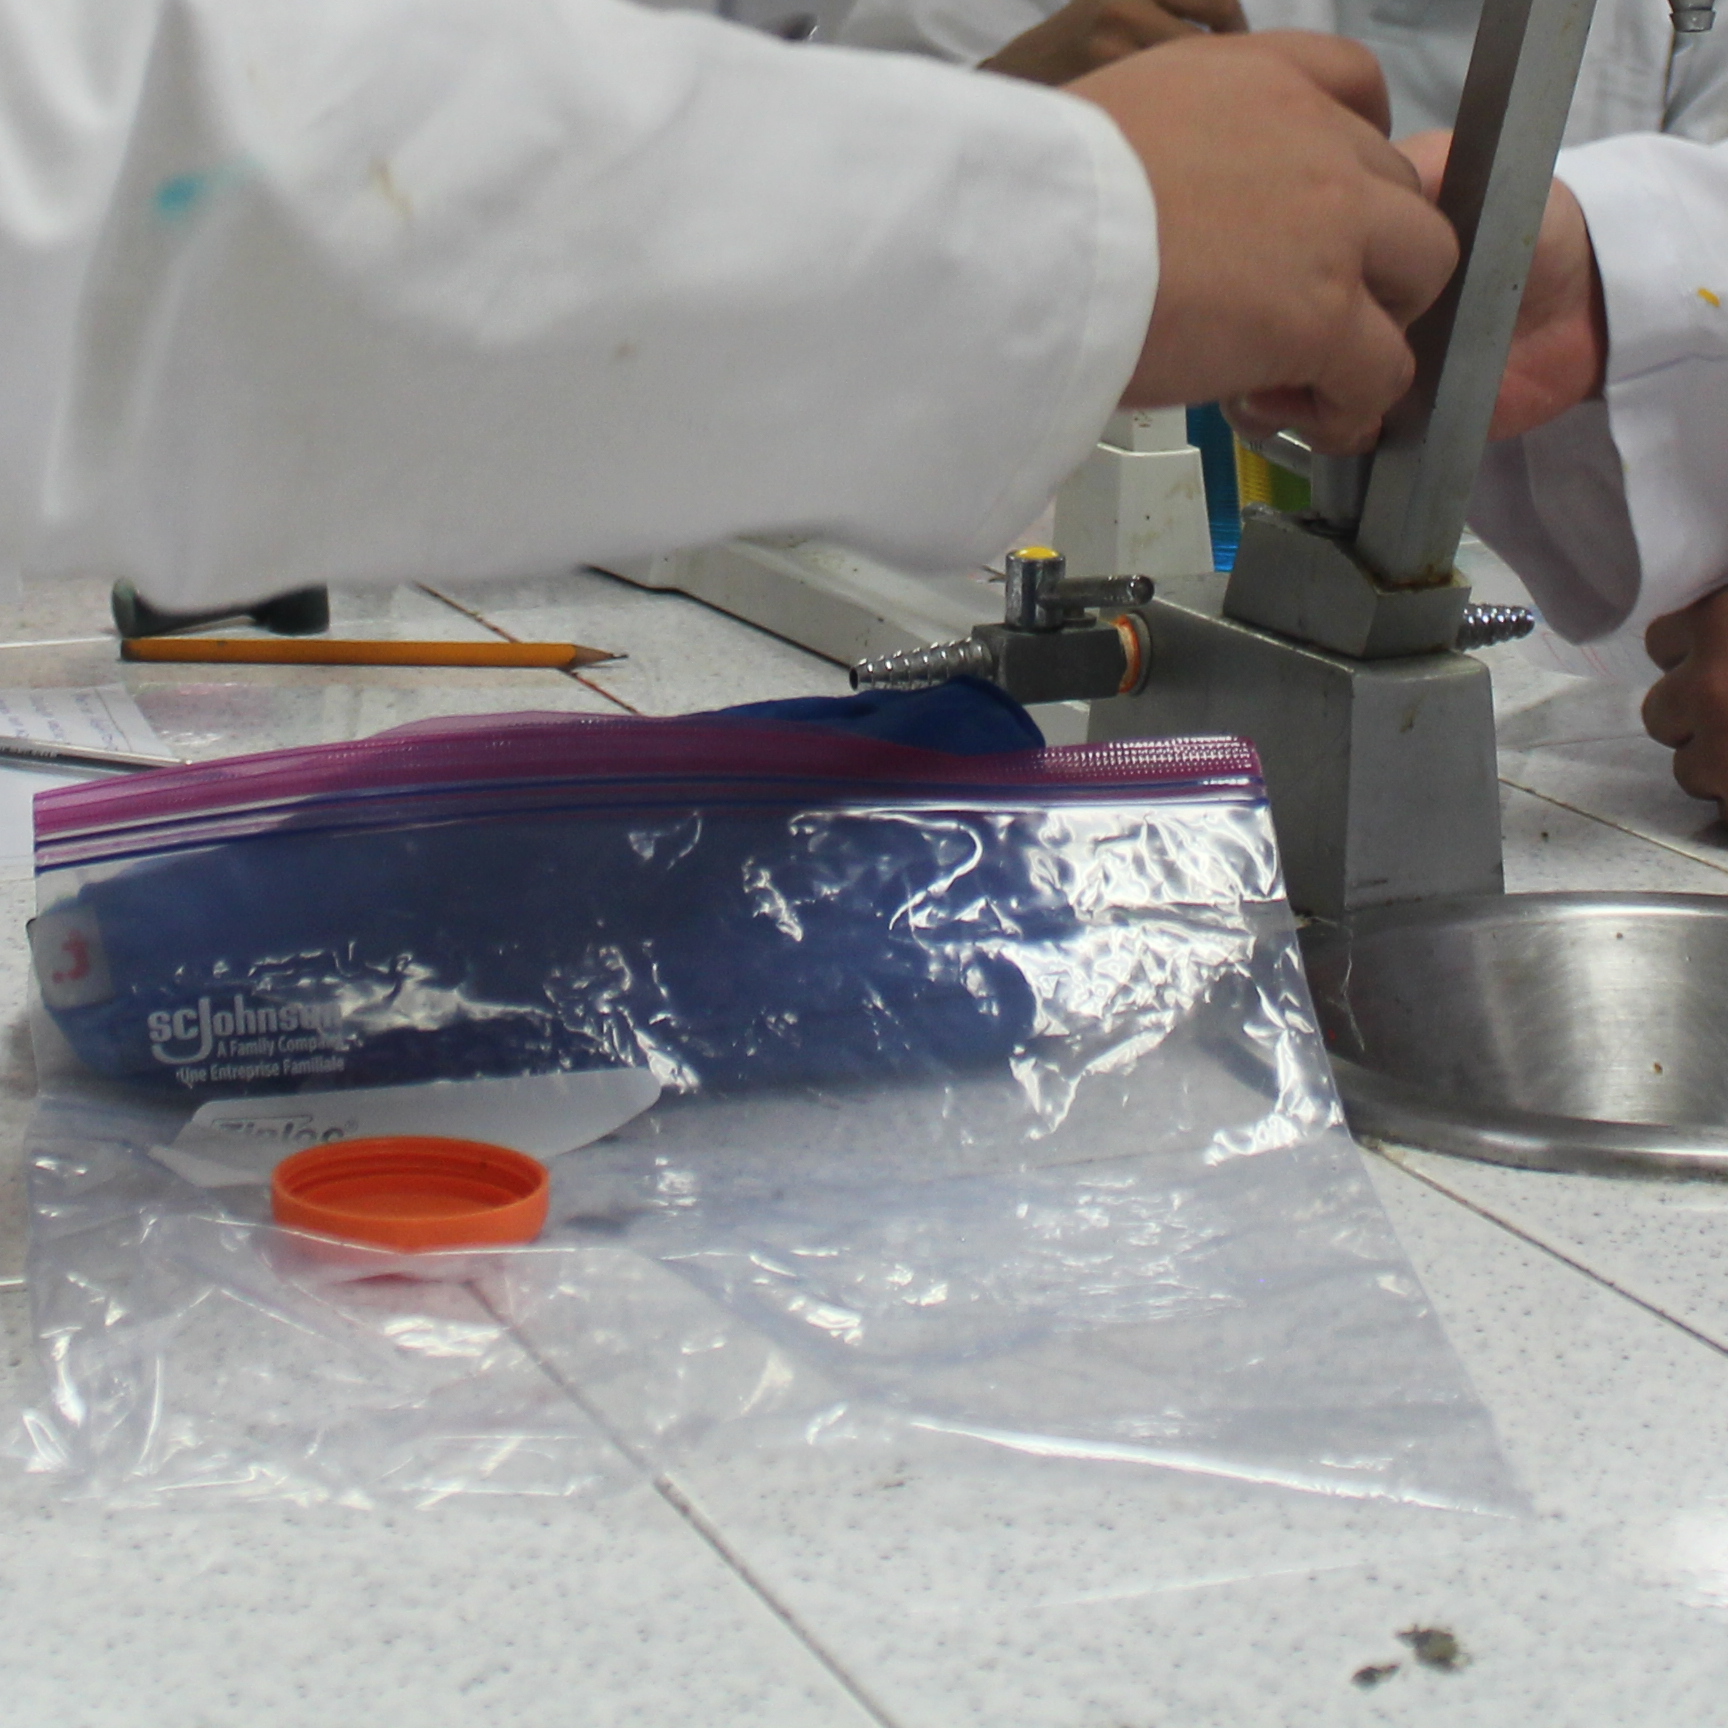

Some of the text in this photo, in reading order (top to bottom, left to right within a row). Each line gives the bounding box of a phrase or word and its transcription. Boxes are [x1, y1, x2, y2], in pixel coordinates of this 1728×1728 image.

[217, 1040, 228, 1059] A
[229, 1037, 275, 1058] Family
[209, 1059, 281, 1083] Entreprise
[282, 1054, 346, 1076] Familiale
